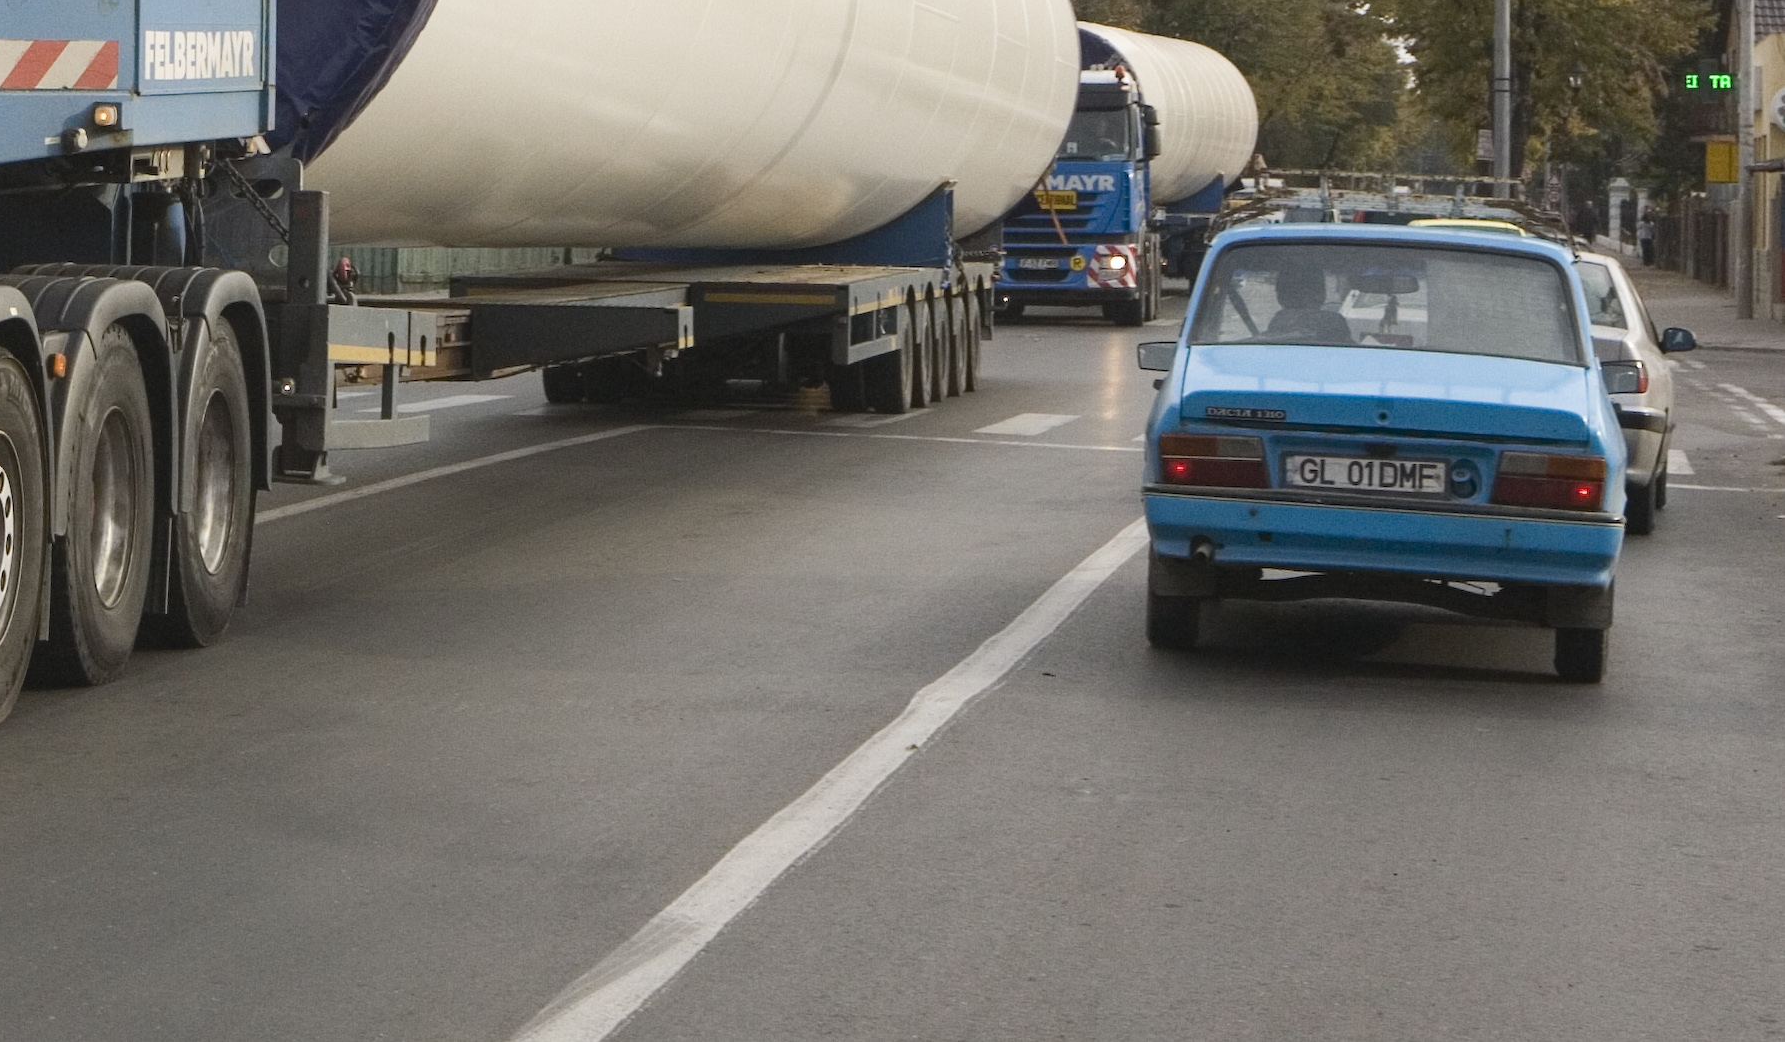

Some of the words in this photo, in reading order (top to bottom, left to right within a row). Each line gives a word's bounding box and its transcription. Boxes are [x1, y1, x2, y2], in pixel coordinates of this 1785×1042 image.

[145, 30, 255, 81] FELBERMAYR
[1709, 74, 1732, 89] TA
[1257, 410, 1285, 419] 1310
[1299, 458, 1335, 485] GL
